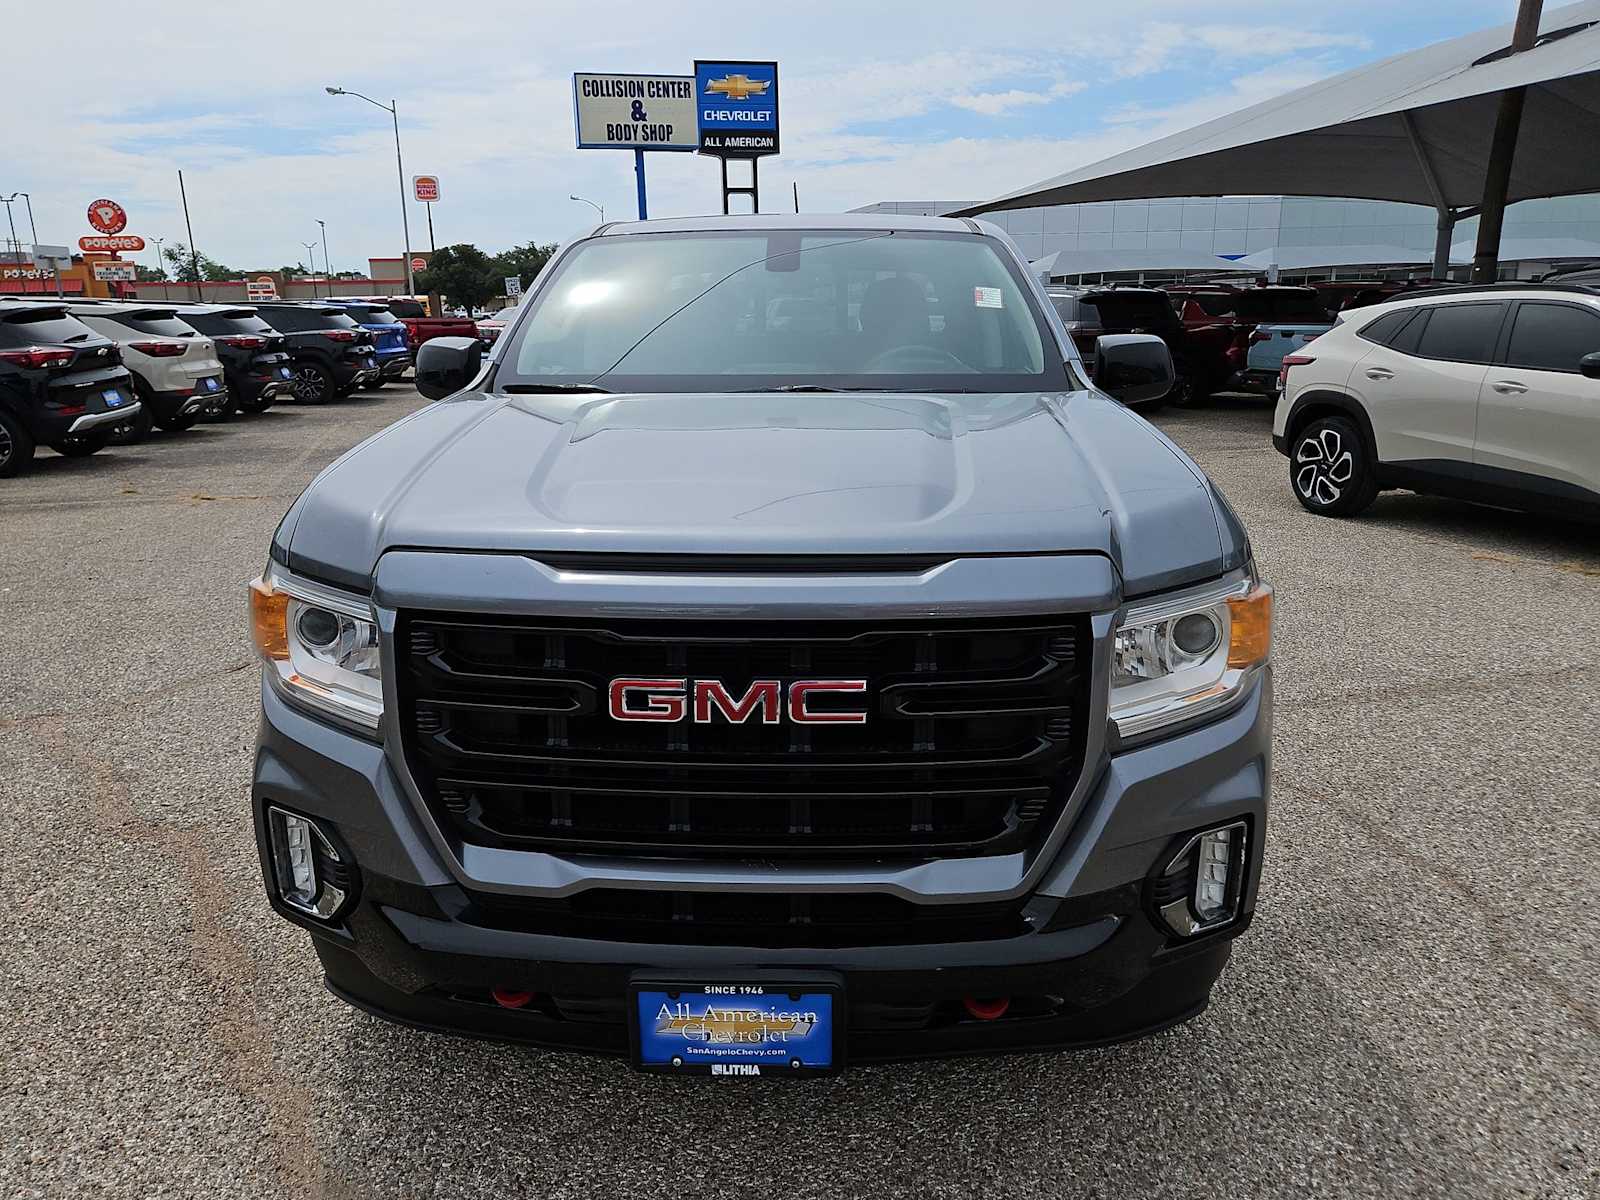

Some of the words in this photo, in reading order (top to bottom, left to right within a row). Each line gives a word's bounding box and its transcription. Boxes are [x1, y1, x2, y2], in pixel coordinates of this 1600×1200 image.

[582, 79, 644, 98] COLLISION
[647, 81, 691, 98] CENTER
[631, 100, 647, 122] &
[704, 110, 771, 121] CHEVROLET
[606, 123, 638, 142] BODY
[642, 124, 673, 142] SHOP
[704, 137, 722, 147] ALL
[724, 137, 774, 148] AMERICAN
[609, 678, 867, 724] GMC
[704, 986, 736, 994] SINCE
[739, 986, 764, 994] 1946
[655, 1002, 690, 1020] All
[701, 1005, 818, 1022] American
[681, 1023, 789, 1043] Chevrolet
[686, 1046, 786, 1056] SanAngeloChevy.com
[722, 1064, 761, 1075] LITHIA
